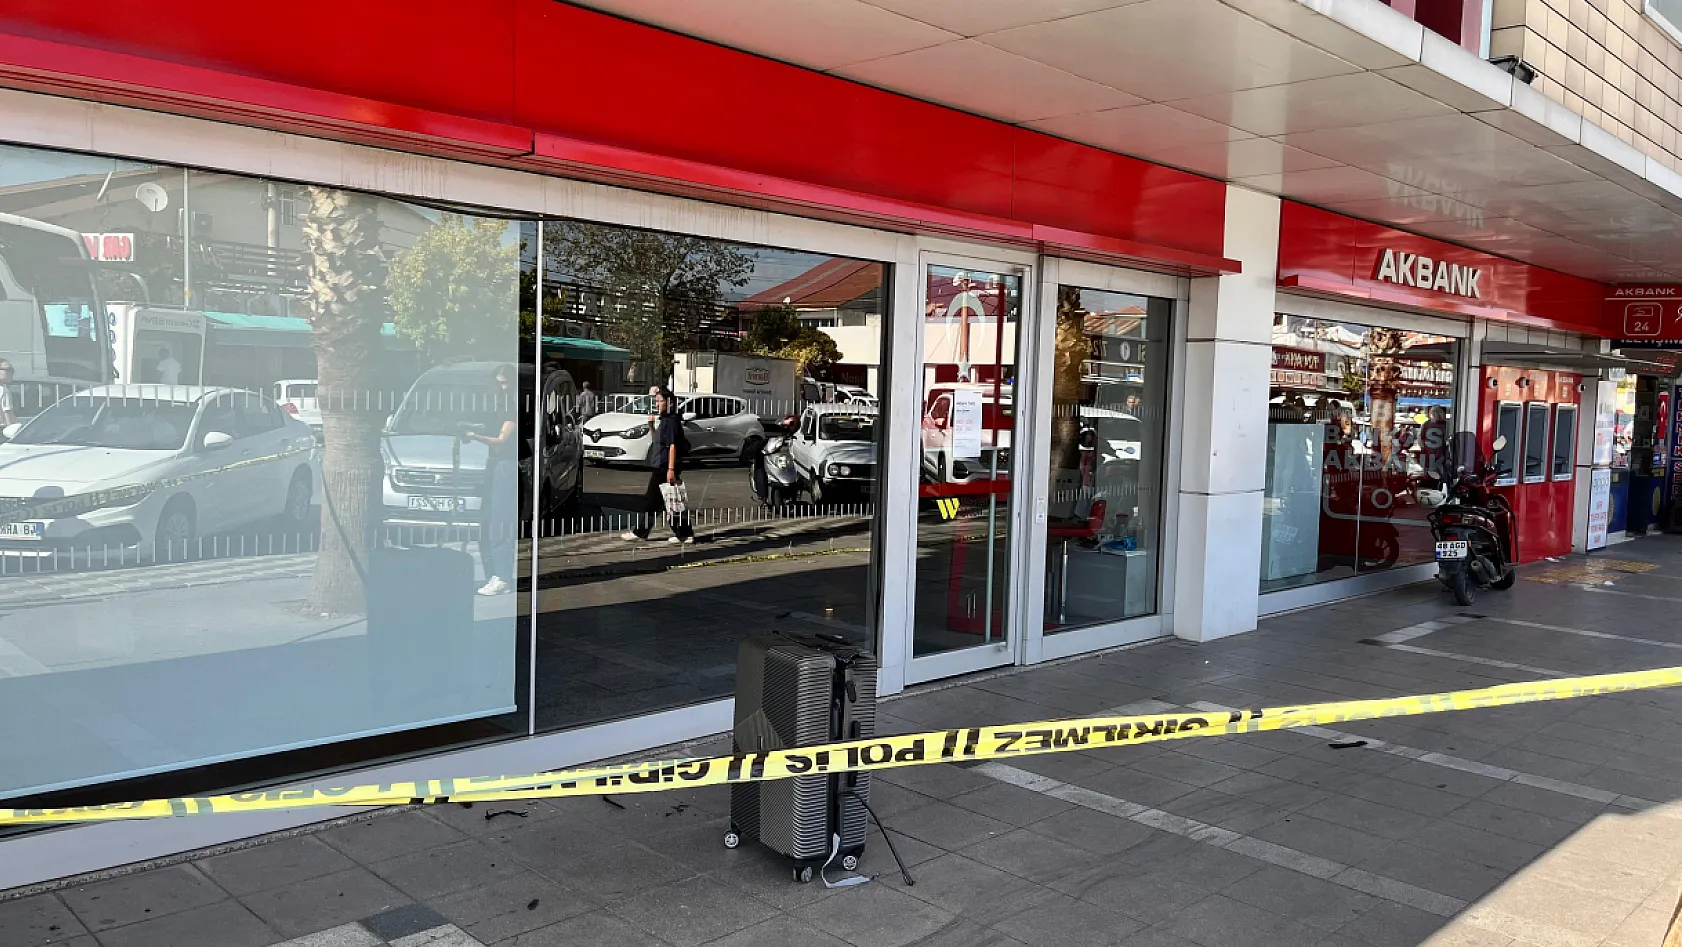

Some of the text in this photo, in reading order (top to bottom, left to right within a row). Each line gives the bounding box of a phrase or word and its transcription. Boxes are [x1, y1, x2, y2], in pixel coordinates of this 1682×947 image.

[1377, 248, 1482, 298] AKBANK
[1615, 288, 1675, 296] AKBANK
[1634, 321, 1649, 332] 24
